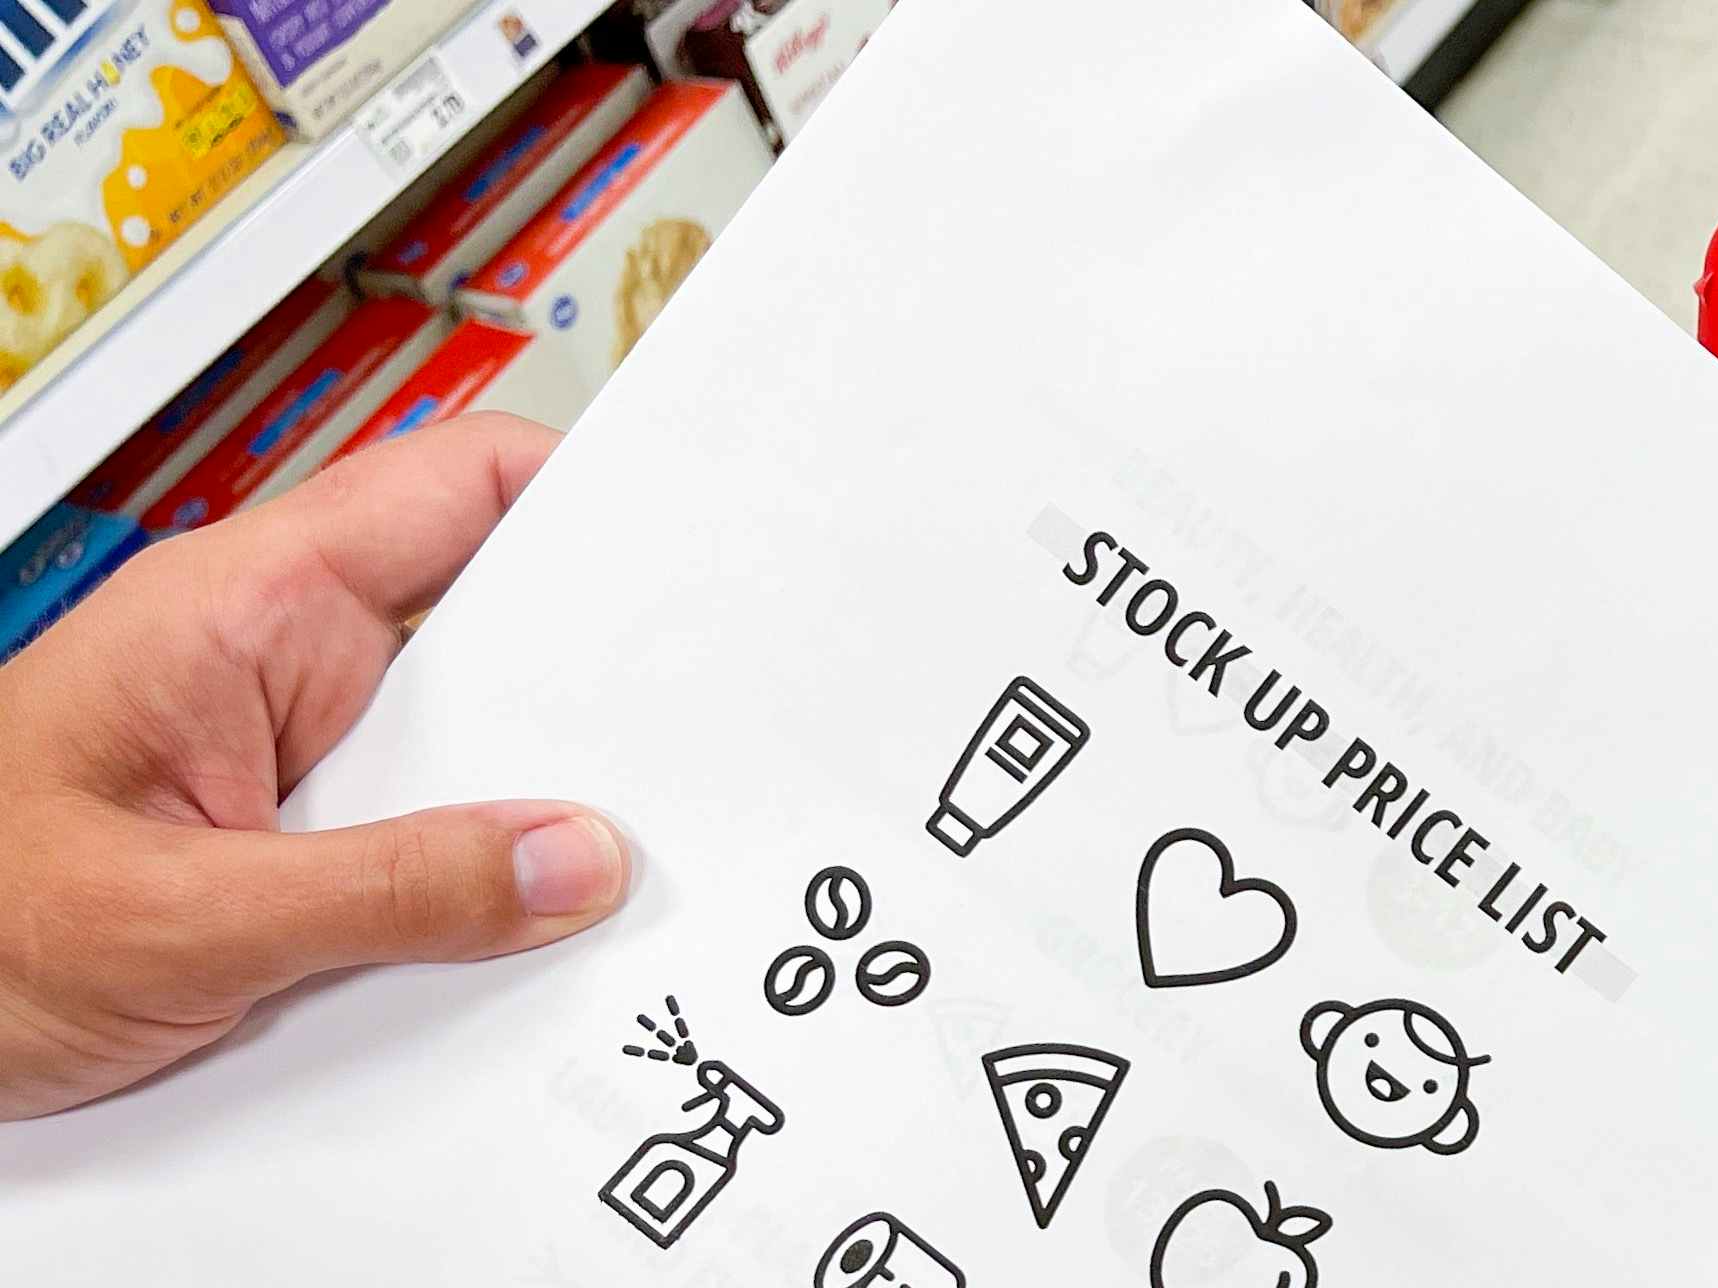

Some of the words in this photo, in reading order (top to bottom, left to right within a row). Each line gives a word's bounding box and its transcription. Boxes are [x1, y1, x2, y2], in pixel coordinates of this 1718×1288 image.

[9, 138, 47, 181] BIG
[41, 91, 92, 145] REAL
[1062, 531, 1252, 697] STOCK
[1243, 668, 1331, 750] UP
[1321, 737, 1490, 888] PRICE
[1477, 862, 1607, 974] LIST
